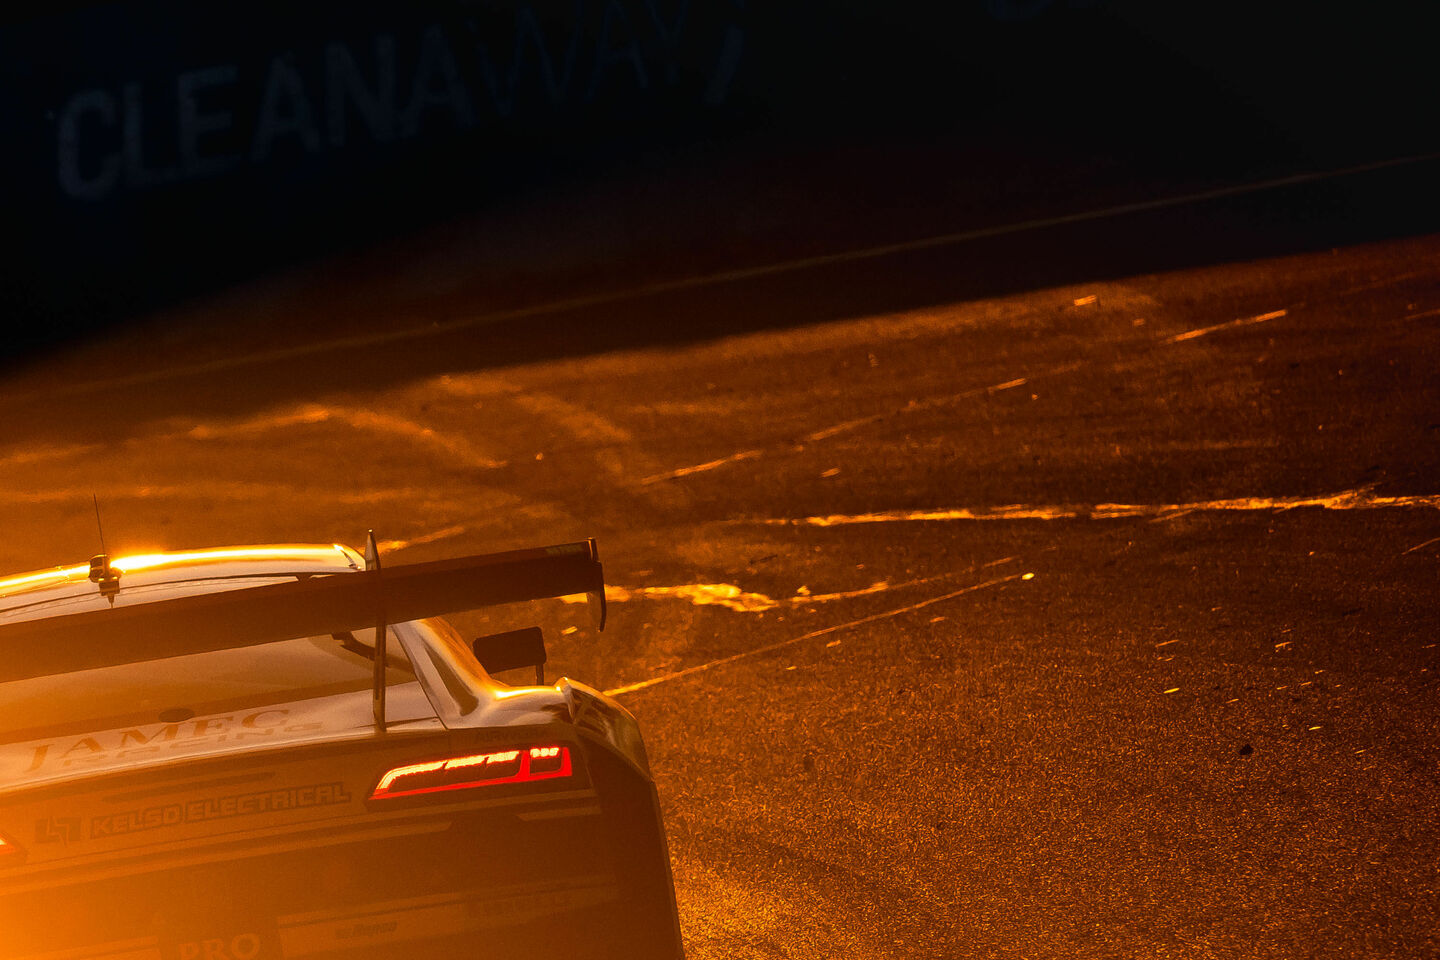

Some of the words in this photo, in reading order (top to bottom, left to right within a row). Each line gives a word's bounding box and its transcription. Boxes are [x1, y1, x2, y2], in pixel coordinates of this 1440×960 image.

[58, 0, 688, 201] CLEANAWAY
[23, 708, 291, 772] JAMEC
[92, 804, 183, 834] KELSO
[186, 784, 350, 822] ELECTRICAL
